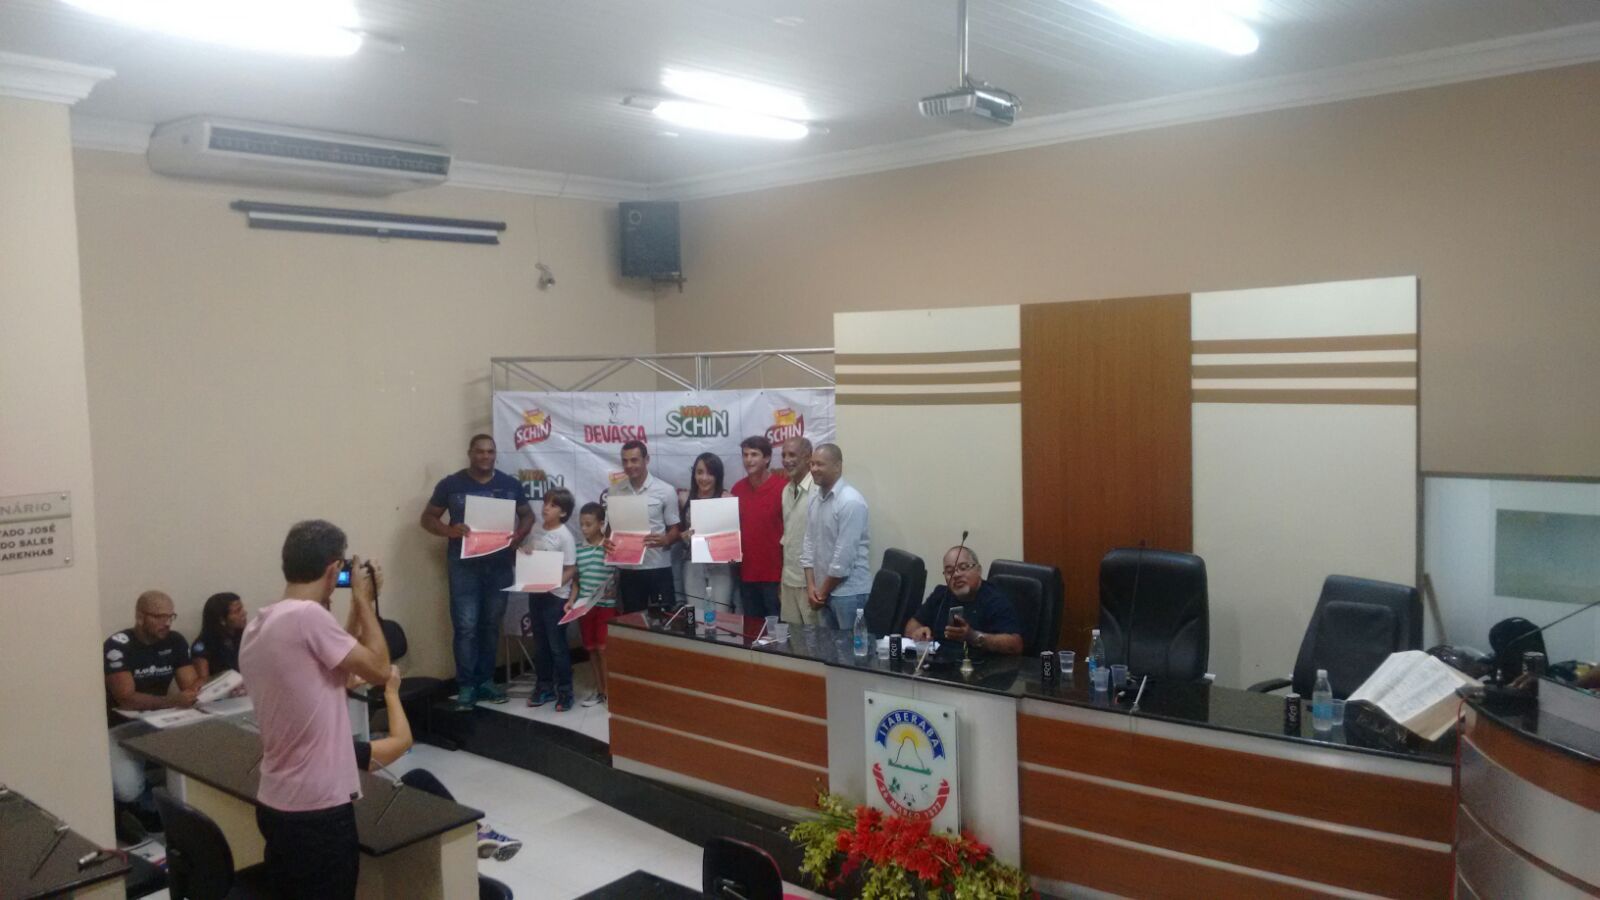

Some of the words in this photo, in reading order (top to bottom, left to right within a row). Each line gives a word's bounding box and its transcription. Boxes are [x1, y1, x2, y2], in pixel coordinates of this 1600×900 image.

[681, 405, 712, 417] VIVA
[516, 421, 550, 444] SCHIN
[666, 409, 729, 437] SCHIN
[766, 422, 802, 444] SCHIN
[584, 425, 647, 444] DEVASSA
[512, 474, 565, 499] CHIN
[0, 529, 25, 537] ADO
[27, 523, 56, 535] JOSÉ
[20, 536, 54, 547] SALES
[2, 548, 54, 561] ARENHAS
[879, 712, 940, 748] ITABERABA
